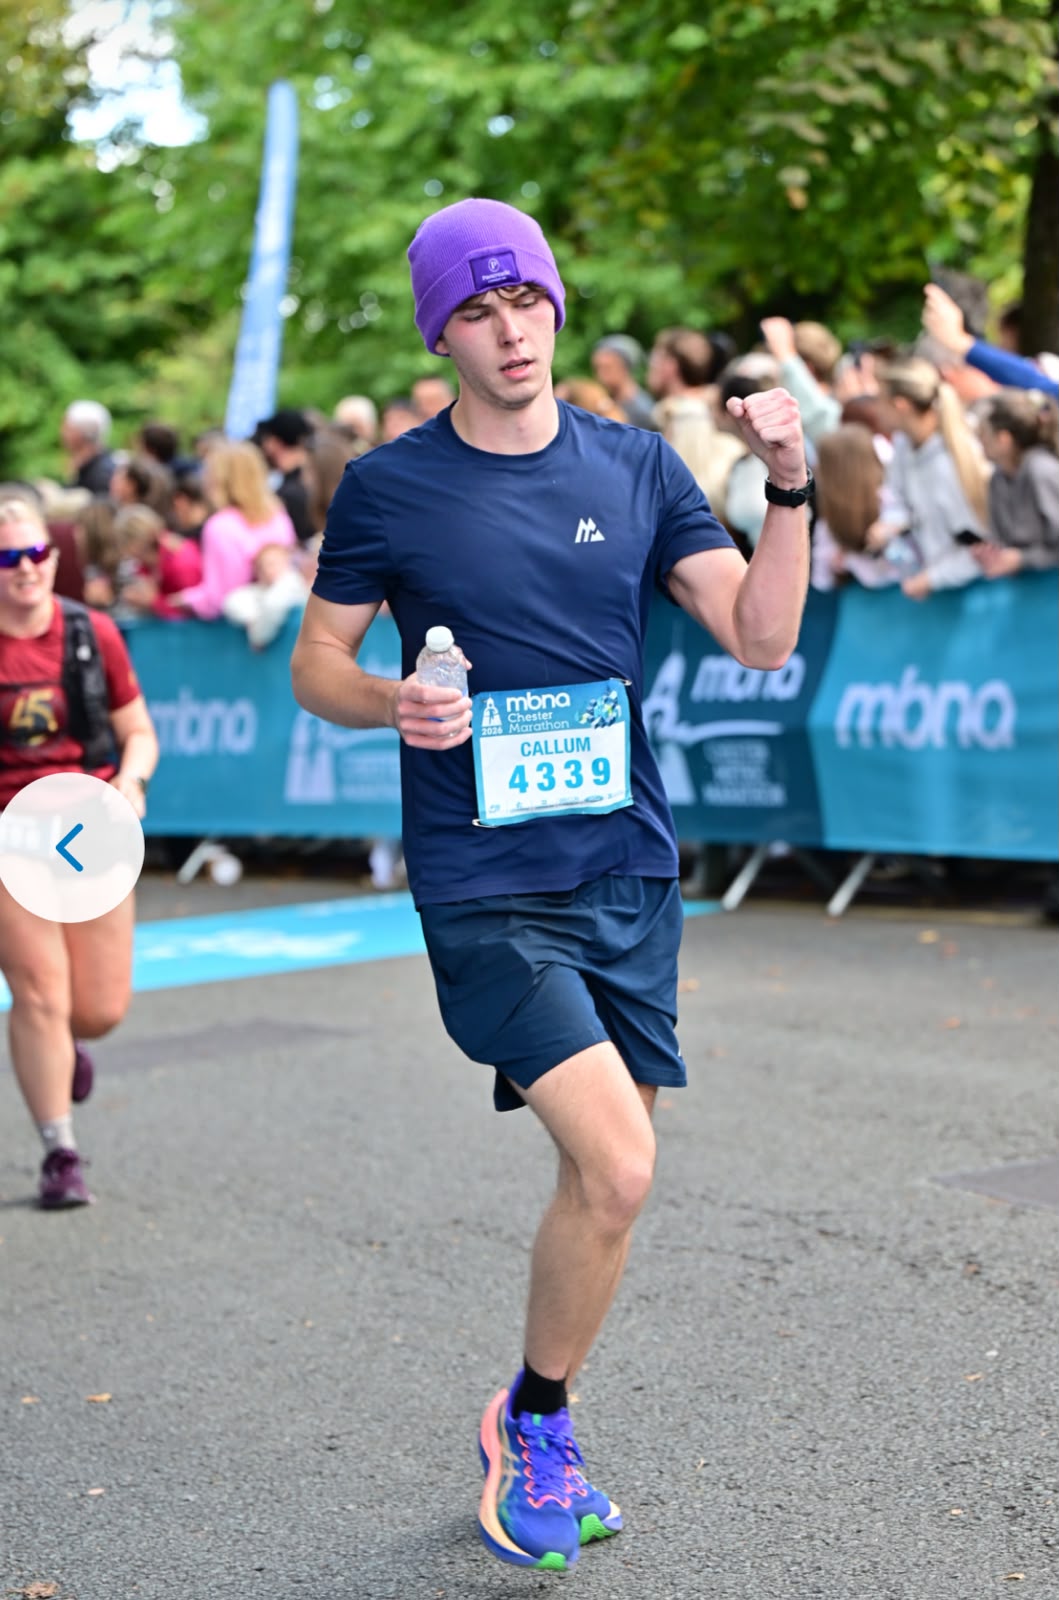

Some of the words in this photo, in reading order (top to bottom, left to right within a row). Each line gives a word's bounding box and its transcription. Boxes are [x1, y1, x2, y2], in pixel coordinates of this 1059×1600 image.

[506, 691, 571, 712] mbna
[836, 664, 1016, 750] mbna
[507, 711, 553, 723] Chester
[508, 719, 570, 734] Marathon
[481, 726, 503, 736] 2026
[520, 736, 591, 757] CALLUM
[508, 757, 611, 794] 4339
